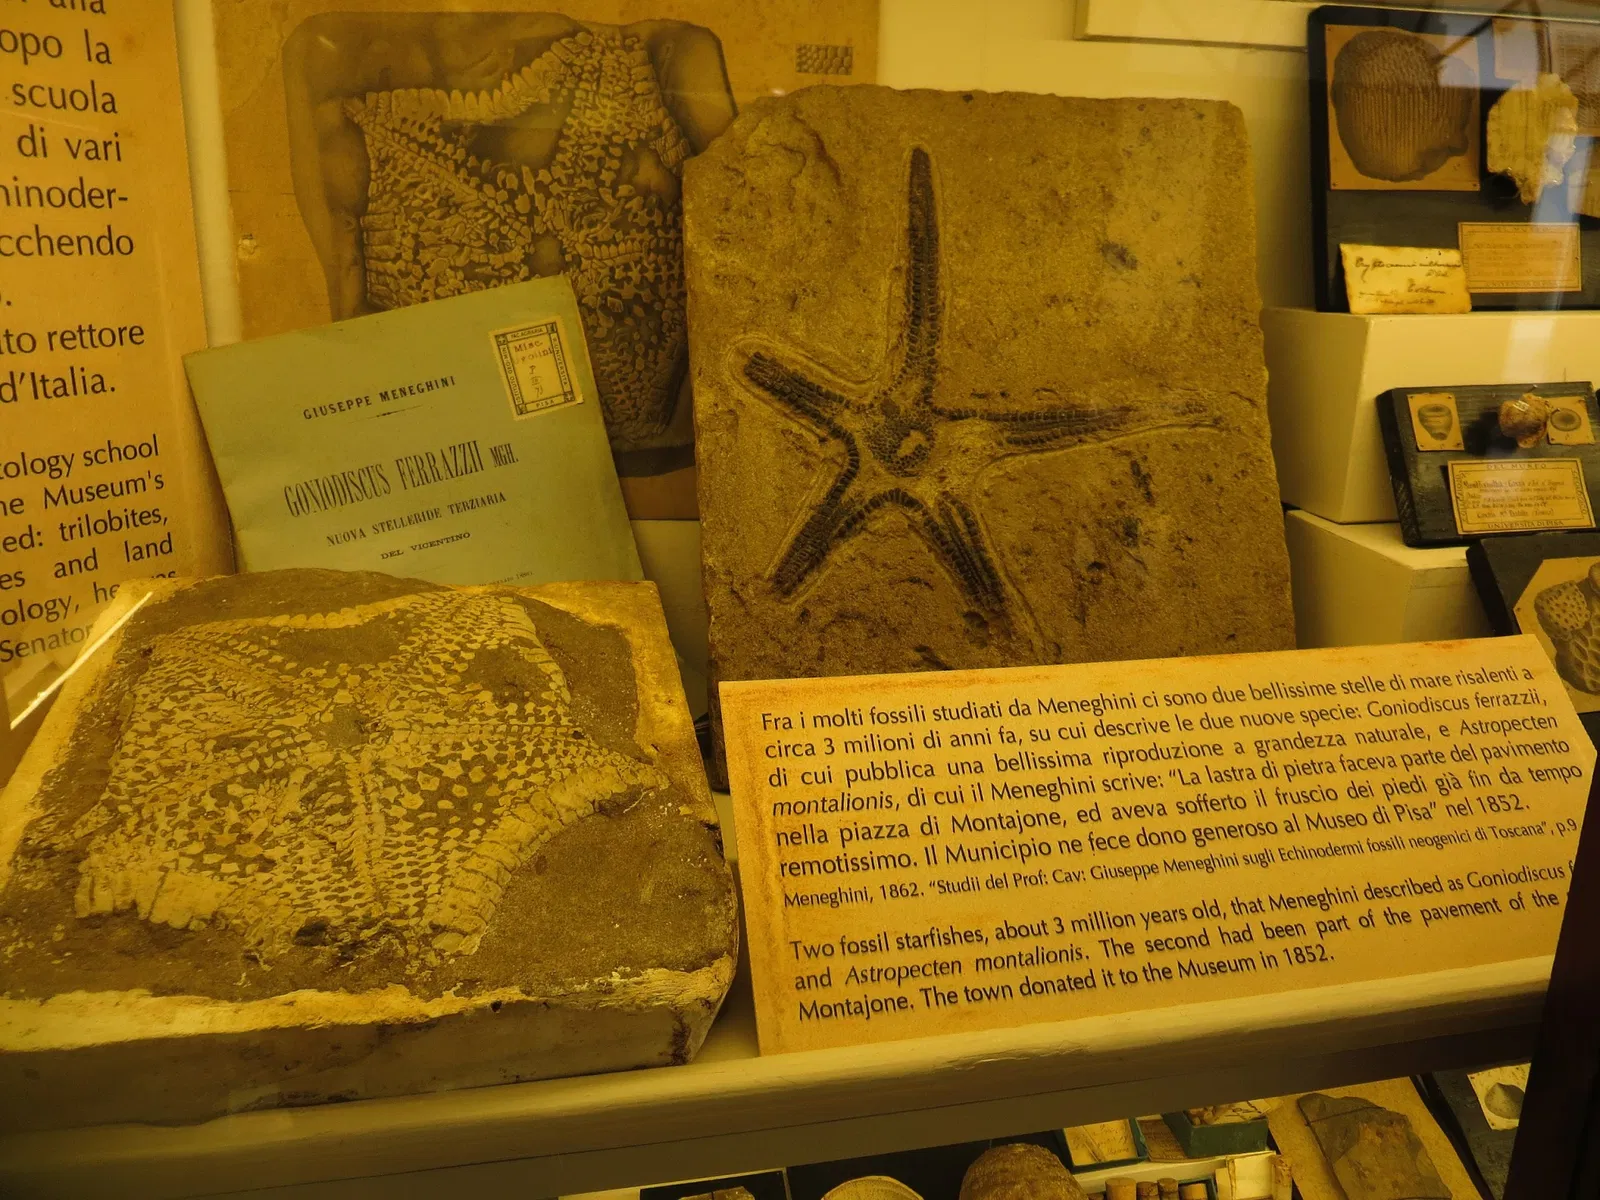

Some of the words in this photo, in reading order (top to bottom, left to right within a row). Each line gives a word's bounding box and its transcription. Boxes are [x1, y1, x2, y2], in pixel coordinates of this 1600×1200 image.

[84, 28, 112, 64] la
[12, 80, 118, 113] scuola
[17, 124, 48, 158] di
[64, 132, 121, 161] vari
[47, 324, 145, 351] rettore
[0, 366, 116, 403] d’Italia.
[303, 395, 372, 420] GIUSEPPE
[379, 375, 456, 402] MENEGHINI
[536, 399, 554, 408] PISA
[83, 433, 159, 467] school
[44, 470, 164, 509] Museum's
[283, 463, 392, 518] GONIODISCUS
[395, 440, 485, 490] FERRAZZII
[488, 443, 519, 468] MGH.
[2, 524, 43, 553] ed:
[59, 507, 168, 541] trilobites,
[326, 527, 367, 547] NUOVA
[372, 507, 443, 535] STELLERIDE
[447, 491, 507, 516] TERZIARIA
[54, 547, 98, 579] and
[124, 532, 173, 563] land
[381, 549, 405, 560] DEL
[410, 531, 471, 551] VICENTINO
[1, 595, 79, 626] ology,
[761, 712, 793, 730] Fra
[799, 711, 805, 728] i
[812, 707, 863, 727] molti
[869, 703, 925, 724] fossili
[932, 700, 1002, 721] studiati
[1008, 697, 1031, 716] da
[1037, 692, 1136, 716] Meneghini
[1142, 690, 1158, 707] ci
[1163, 691, 1207, 706] sono
[1211, 685, 1246, 703] due
[1247, 680, 1336, 700] bellissime
[1340, 675, 1385, 694] stelle
[1389, 673, 1406, 690] di
[1409, 675, 1452, 688] mare
[1455, 665, 1518, 685] risalenti
[1521, 668, 1534, 680] a
[764, 739, 815, 758] circa
[823, 737, 835, 755] 3
[843, 731, 914, 753] milioni
[922, 729, 941, 748] di
[949, 727, 991, 747] anni
[998, 725, 1022, 745] fa,
[1028, 728, 1050, 742] su
[1057, 721, 1086, 740] cui
[1093, 717, 1170, 737] descrive
[1174, 713, 1194, 731] le
[1199, 711, 1234, 729] due
[1239, 711, 1294, 726] nuove
[1299, 703, 1361, 727] specie:
[1366, 695, 1469, 717] Goniodiscus
[1474, 688, 1546, 708] ferrazzii,
[768, 766, 787, 787] di
[800, 765, 832, 785] cui
[845, 759, 935, 788] pubblica
[947, 760, 984, 775] una
[993, 750, 1092, 771] bellissima
[1102, 741, 1223, 768] riproduzione
[1233, 741, 1245, 754] a
[1253, 731, 1346, 758] grandezza
[1354, 722, 1430, 744] naturale,
[1438, 724, 1450, 737] e
[1460, 715, 1557, 736] Astropecten
[772, 790, 899, 816] montalionis,
[907, 786, 926, 807] di
[933, 784, 964, 805] cui
[970, 782, 983, 802] il
[990, 775, 1095, 802] Meneghini
[1101, 772, 1163, 792] scrive:
[1168, 768, 1201, 785] “La
[1204, 764, 1256, 783] lastra
[1261, 760, 1278, 778] di
[1283, 759, 1336, 782] pietra
[1339, 753, 1397, 771] faceva
[1400, 749, 1446, 772] parte
[1450, 742, 1477, 762] del
[1480, 739, 1569, 764] pavimento
[779, 850, 917, 877] remotissimo.
[924, 844, 937, 865] Il
[945, 837, 1051, 864] Municipio
[1057, 838, 1082, 854] ne
[1087, 831, 1130, 851] fece
[1135, 826, 1186, 847] dono
[1191, 821, 1278, 847] generoso
[1283, 812, 1300, 833] al
[1304, 812, 1367, 830] Museo
[1372, 804, 1390, 824] di
[1392, 801, 1436, 822] Pisa”
[1445, 796, 1473, 817] nel
[1475, 793, 1529, 813] 1852.
[783, 885, 873, 908] Meneghini,
[879, 882, 924, 899] 1862.
[928, 875, 980, 894] “Studii
[985, 872, 1008, 890] del
[1012, 869, 1048, 887] Prof:
[1051, 868, 1086, 883] Cav:
[1089, 863, 1159, 881] Giuseppe
[1163, 852, 1239, 873] Meneghini
[1242, 847, 1275, 868] sugli
[1277, 840, 1364, 861] Echinodermi
[1366, 835, 1405, 852] fossili
[1408, 829, 1471, 850] neogenici
[1474, 826, 1488, 840] di
[1488, 821, 1555, 839] Toscana”,
[1555, 818, 1577, 837] p.9
[788, 940, 834, 960] Two
[839, 930, 889, 955] fossil
[895, 924, 988, 950] starfishes,
[995, 919, 1049, 940] about
[1052, 916, 1064, 934] 3
[1070, 910, 1135, 933] million
[1139, 908, 1187, 930] years
[1191, 898, 1226, 920] old,
[1230, 896, 1265, 915] that
[1267, 884, 1359, 911] Meneghini
[1363, 874, 1443, 900] described
[1447, 877, 1464, 891] as
[1466, 864, 1565, 888] Goniodiscus
[794, 966, 831, 990] and
[844, 959, 961, 987] Astropecten
[975, 943, 1089, 972] montalionis.
[1097, 937, 1134, 958] The
[1144, 927, 1210, 953] second
[1217, 922, 1253, 945] had
[1260, 921, 1306, 939] been
[1315, 915, 1350, 940] part
[1358, 908, 1375, 928] of
[1383, 906, 1412, 925] the
[1419, 897, 1502, 927] pavement
[1508, 891, 1525, 910] of
[1531, 889, 1559, 907] the
